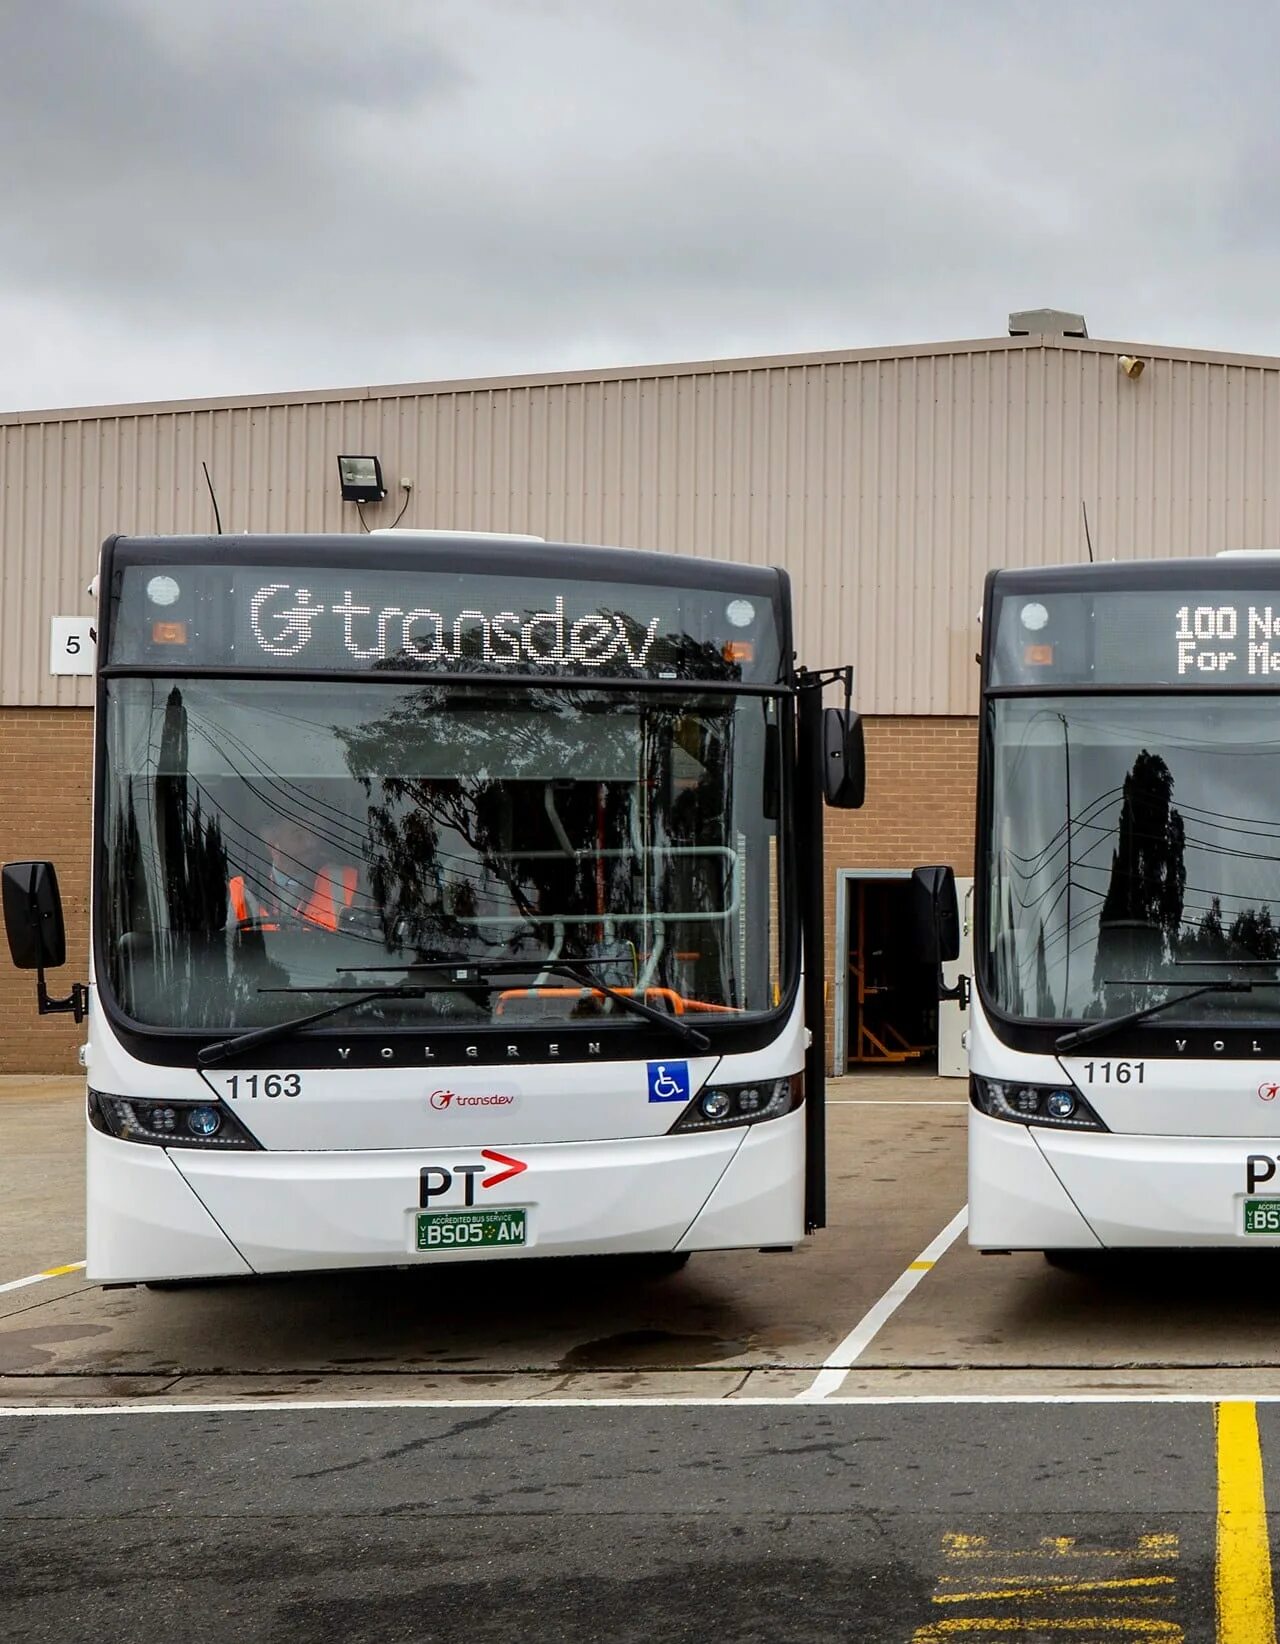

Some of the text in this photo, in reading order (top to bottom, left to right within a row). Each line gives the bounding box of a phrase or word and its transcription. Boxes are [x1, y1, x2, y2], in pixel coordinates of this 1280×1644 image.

[332, 590, 660, 668] transdev
[1175, 606, 1237, 639] 100
[66, 635, 81, 655] 5
[1178, 641, 1237, 675] For
[337, 1041, 602, 1060] VOLGREN
[1084, 1062, 1147, 1084] 1161
[226, 1073, 302, 1100] 1163
[456, 1094, 515, 1108] transdev
[431, 1216, 472, 1225] ACCREDITED
[485, 1214, 512, 1222] SERVICE
[427, 1221, 524, 1245] BS05 AM
